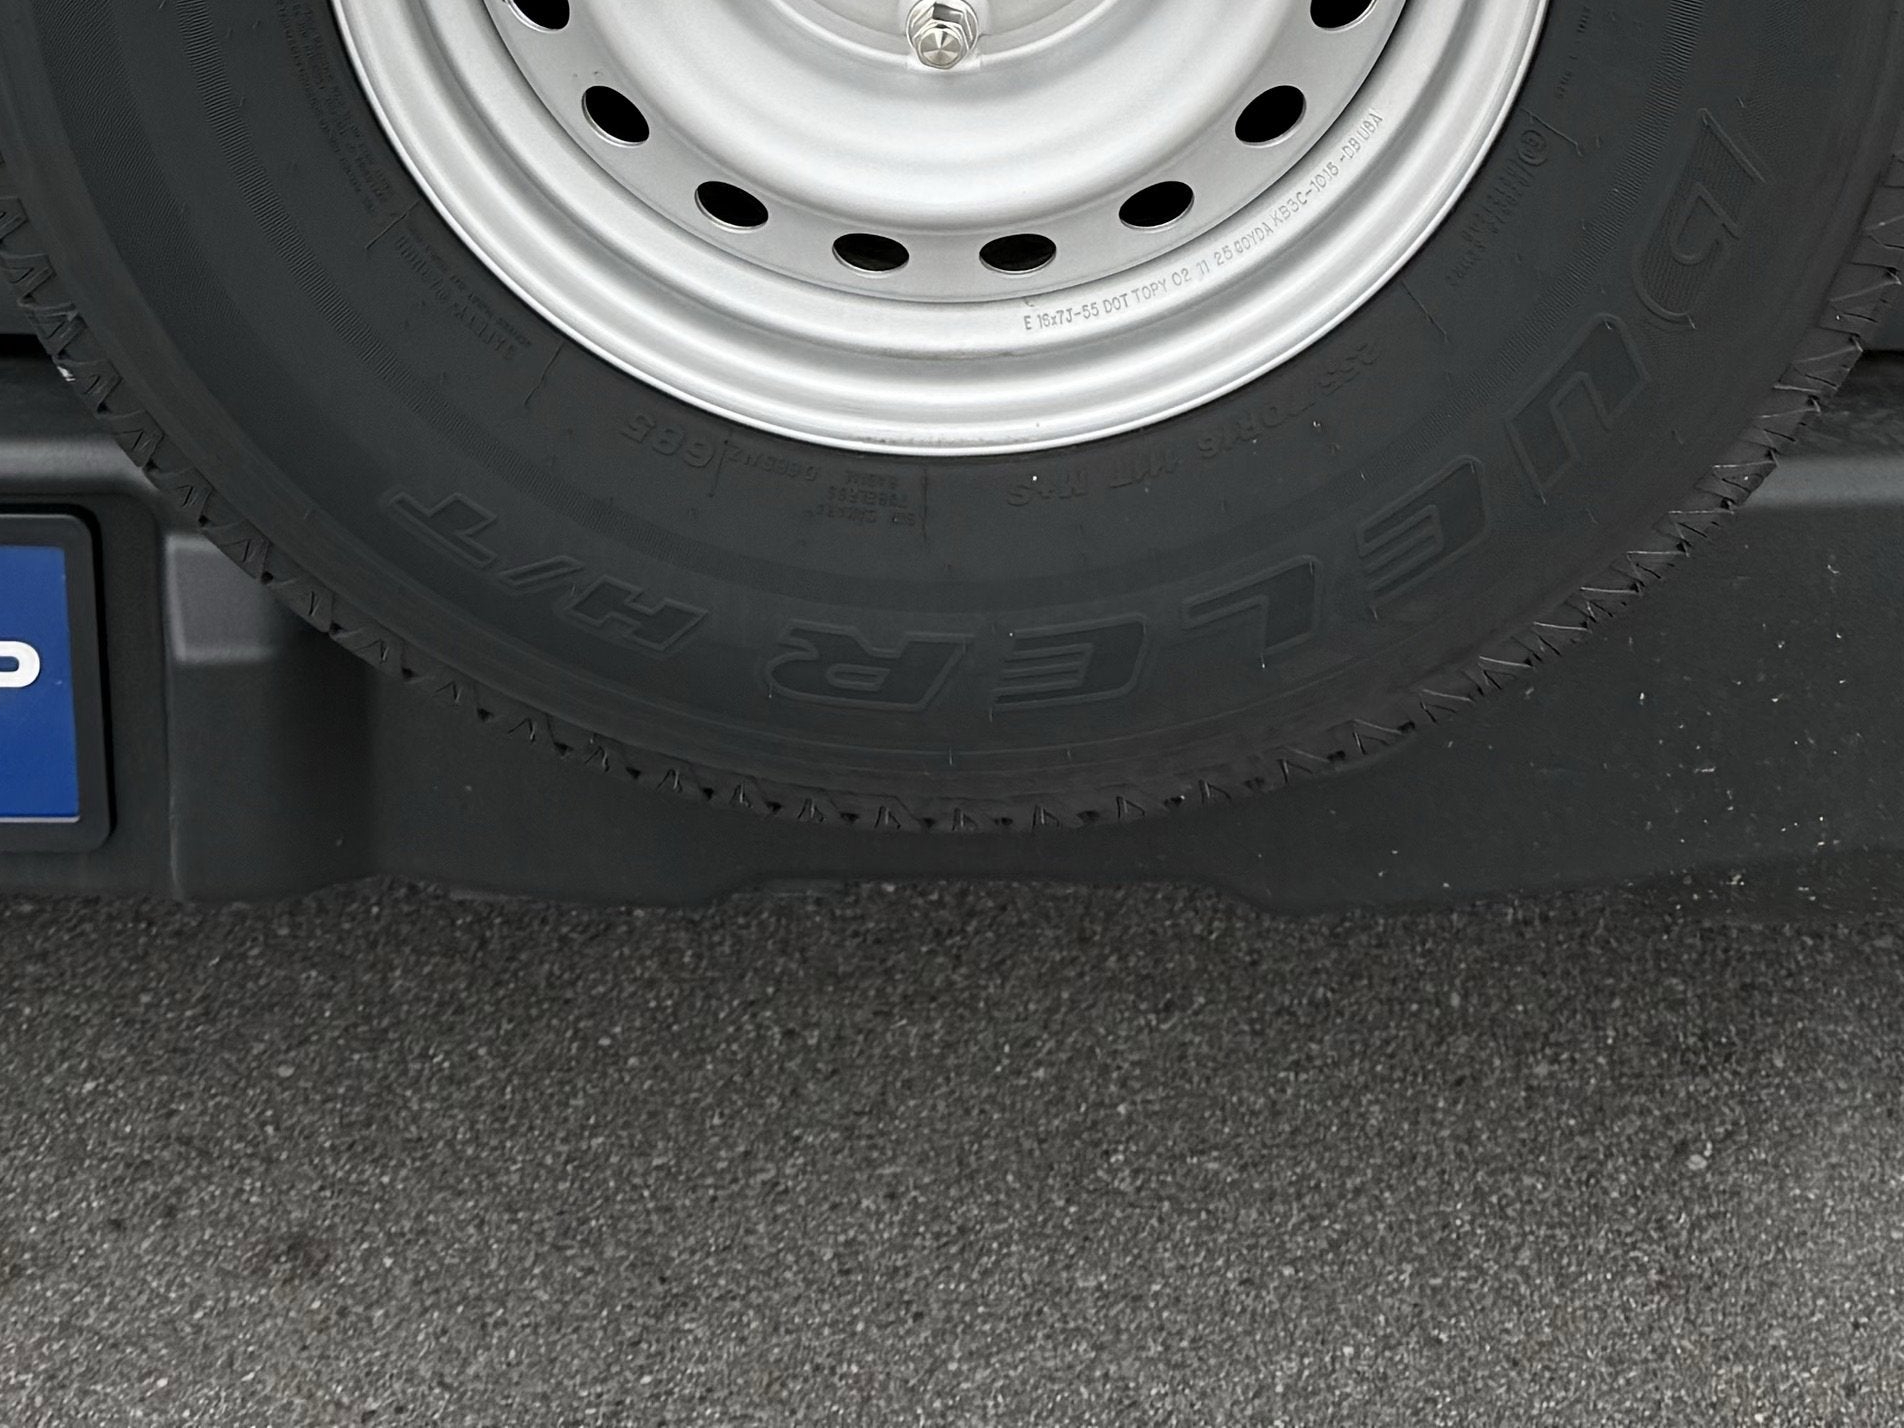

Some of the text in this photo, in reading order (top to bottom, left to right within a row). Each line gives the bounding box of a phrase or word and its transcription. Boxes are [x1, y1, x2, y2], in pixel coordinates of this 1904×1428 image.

[1103, 295, 1129, 315] DOT
[1131, 279, 1167, 308] TOPY
[764, 101, 1770, 719] DUELER
[381, 487, 709, 652] H/T
